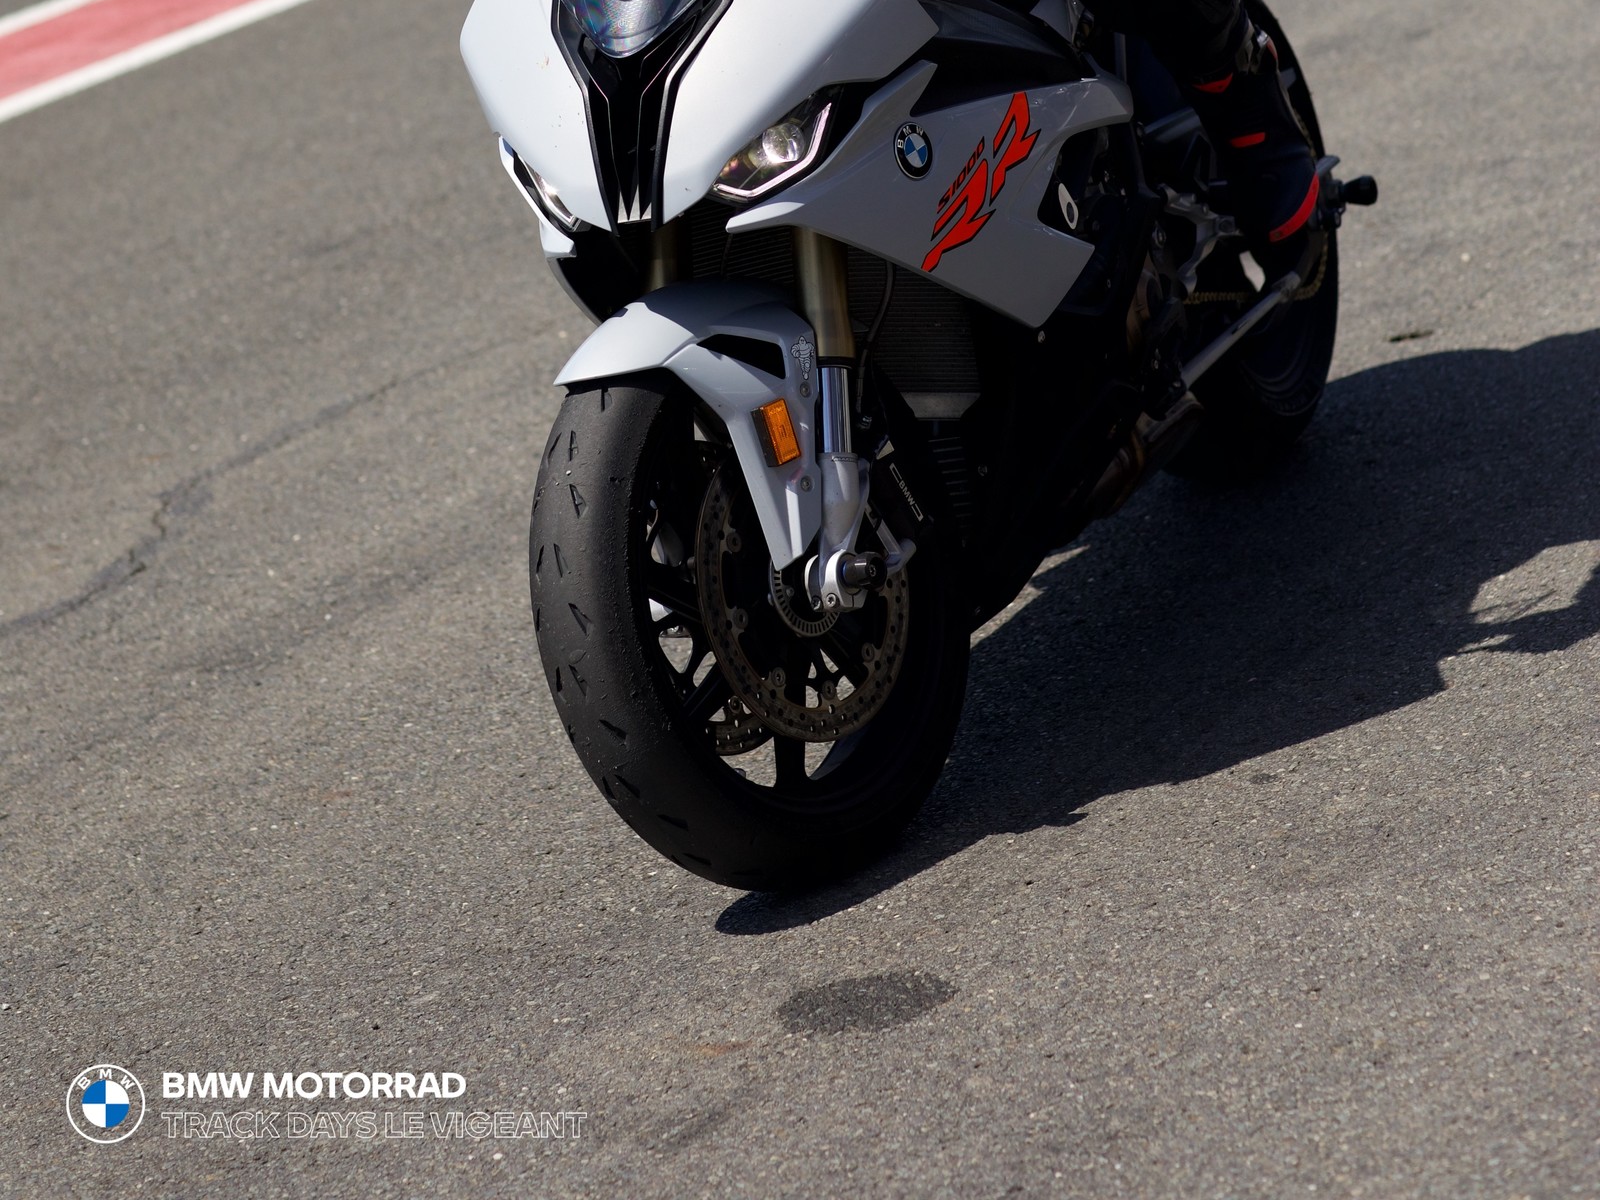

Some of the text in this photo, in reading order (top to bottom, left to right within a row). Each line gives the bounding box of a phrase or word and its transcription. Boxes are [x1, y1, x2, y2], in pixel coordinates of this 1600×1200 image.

[897, 125, 924, 149] BMW
[920, 91, 1042, 273] RR
[899, 480, 916, 506] BMW
